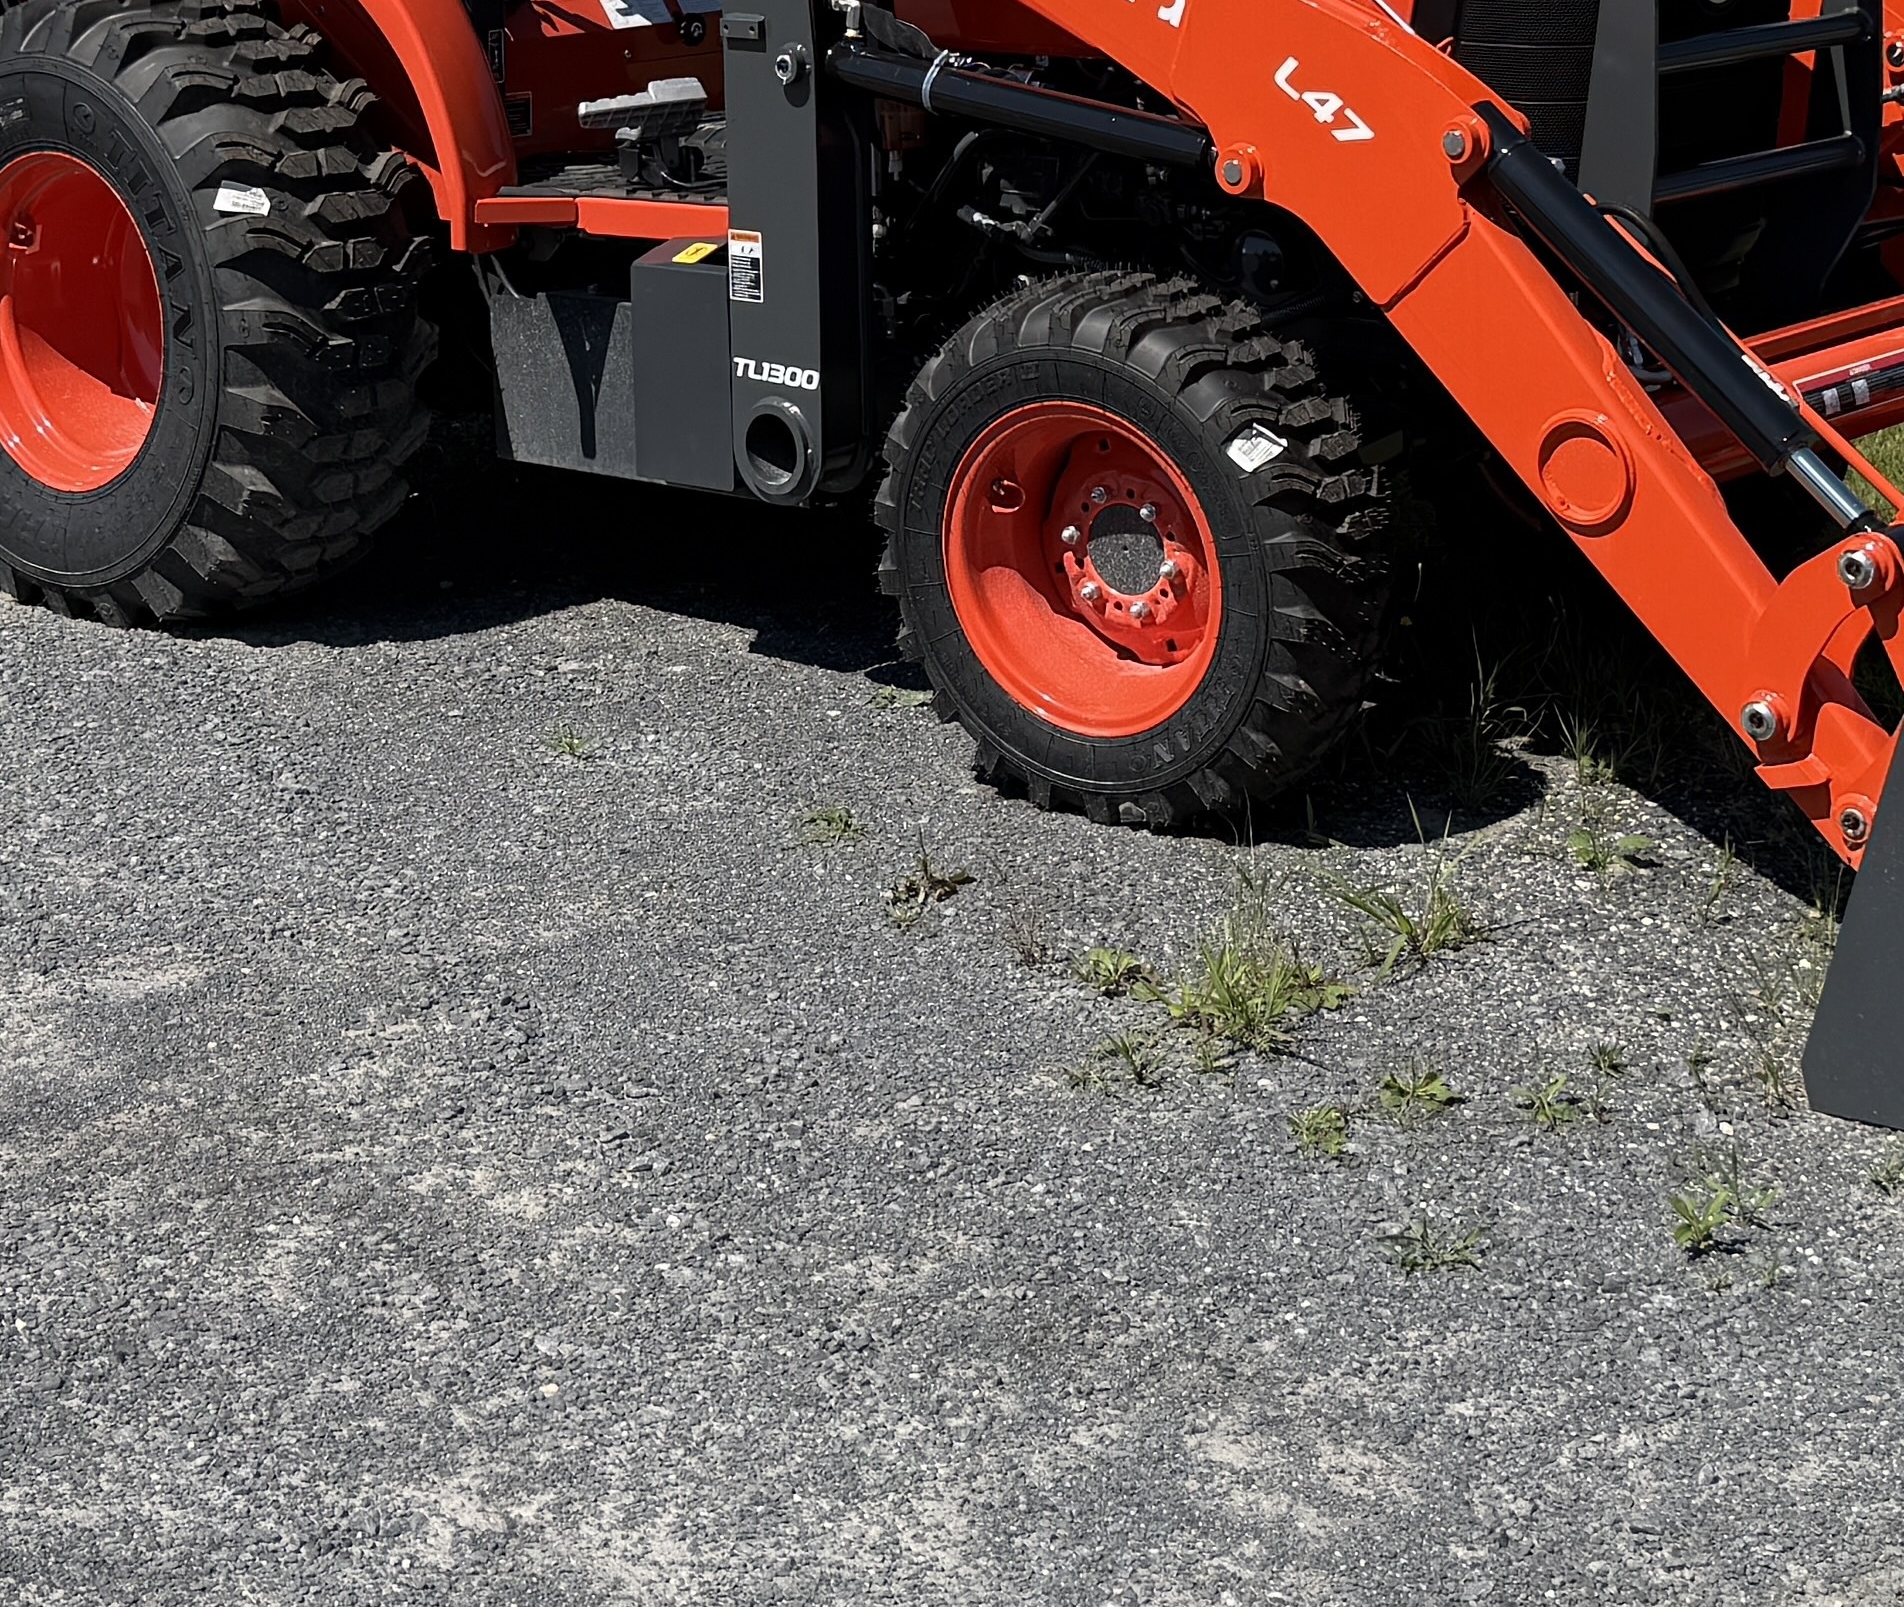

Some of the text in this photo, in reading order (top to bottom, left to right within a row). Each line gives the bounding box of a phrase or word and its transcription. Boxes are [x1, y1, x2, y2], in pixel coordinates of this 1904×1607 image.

[1274, 55, 1376, 142] L47
[103, 128, 198, 351] TITAN
[732, 356, 821, 391] TL1300
